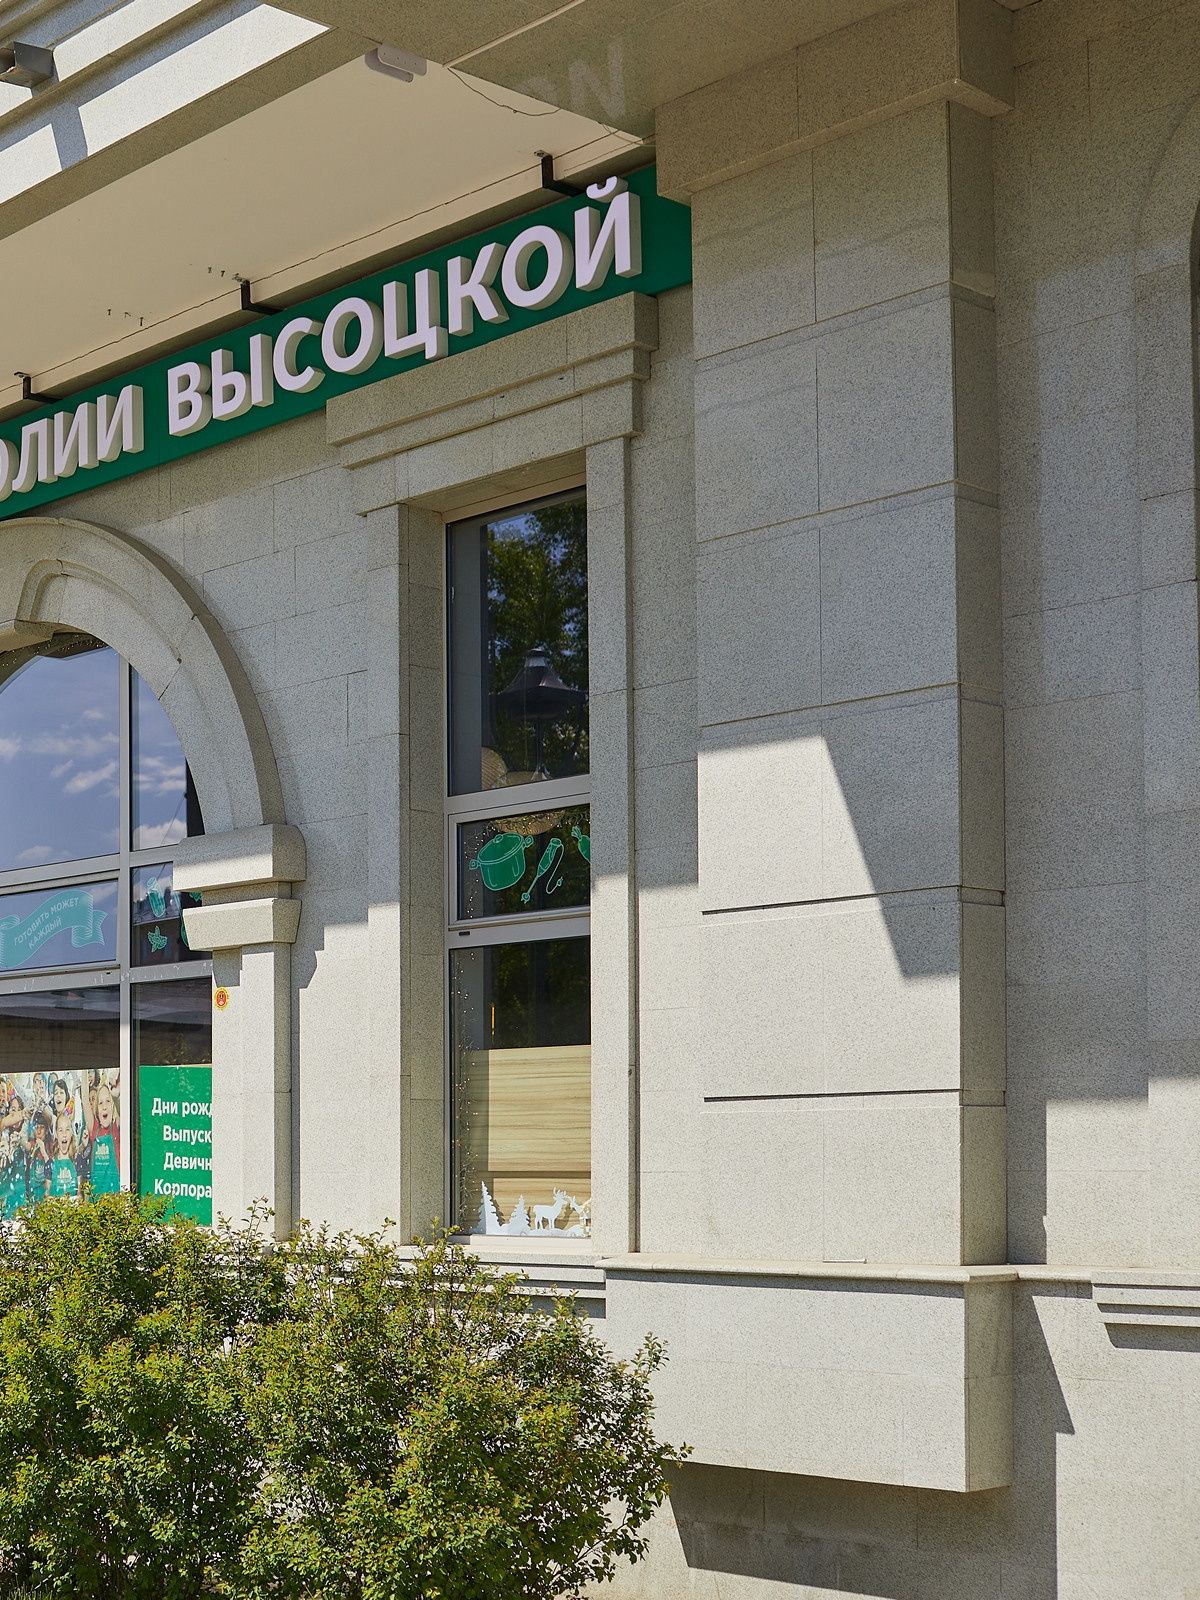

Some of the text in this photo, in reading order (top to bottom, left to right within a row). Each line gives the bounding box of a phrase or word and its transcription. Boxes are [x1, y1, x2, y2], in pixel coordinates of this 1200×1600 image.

[167, 175, 642, 437] ВЫСОЦКОЙ
[14, 897, 79, 946] ГОТОВИТЬ МОЖЕТ
[29, 916, 62, 949] КАЖДЫЙ
[152, 1098, 178, 1116] Дни
[163, 1152, 212, 1171] Девичн
[154, 1179, 212, 1200] Корпора
